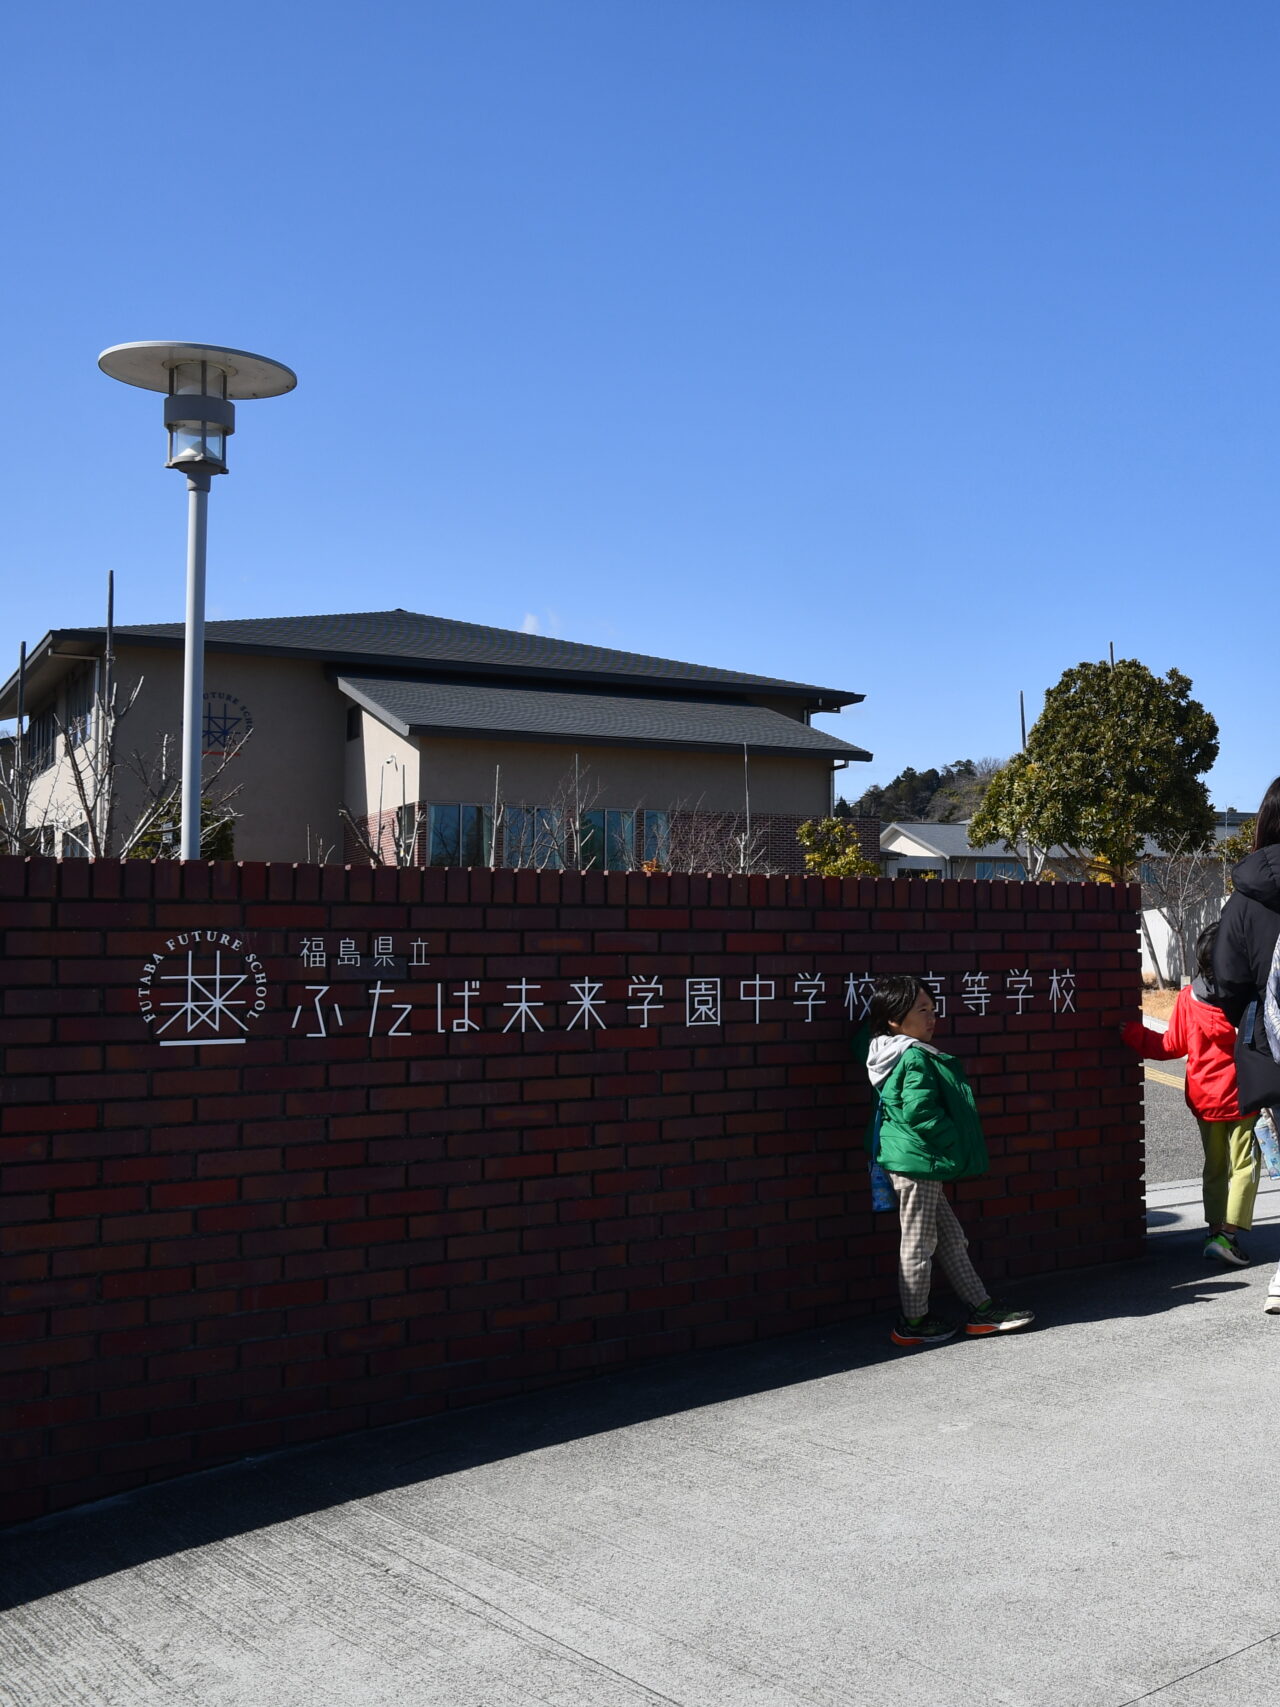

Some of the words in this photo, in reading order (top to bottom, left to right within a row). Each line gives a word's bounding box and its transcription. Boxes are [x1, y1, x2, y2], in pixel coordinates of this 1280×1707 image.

[202, 691, 240, 705] UTURE
[299, 936, 431, 968] 福島県立
[137, 952, 165, 1024] FUTABA
[165, 930, 243, 952] FUTURE
[245, 953, 268, 1020] SCHOOL
